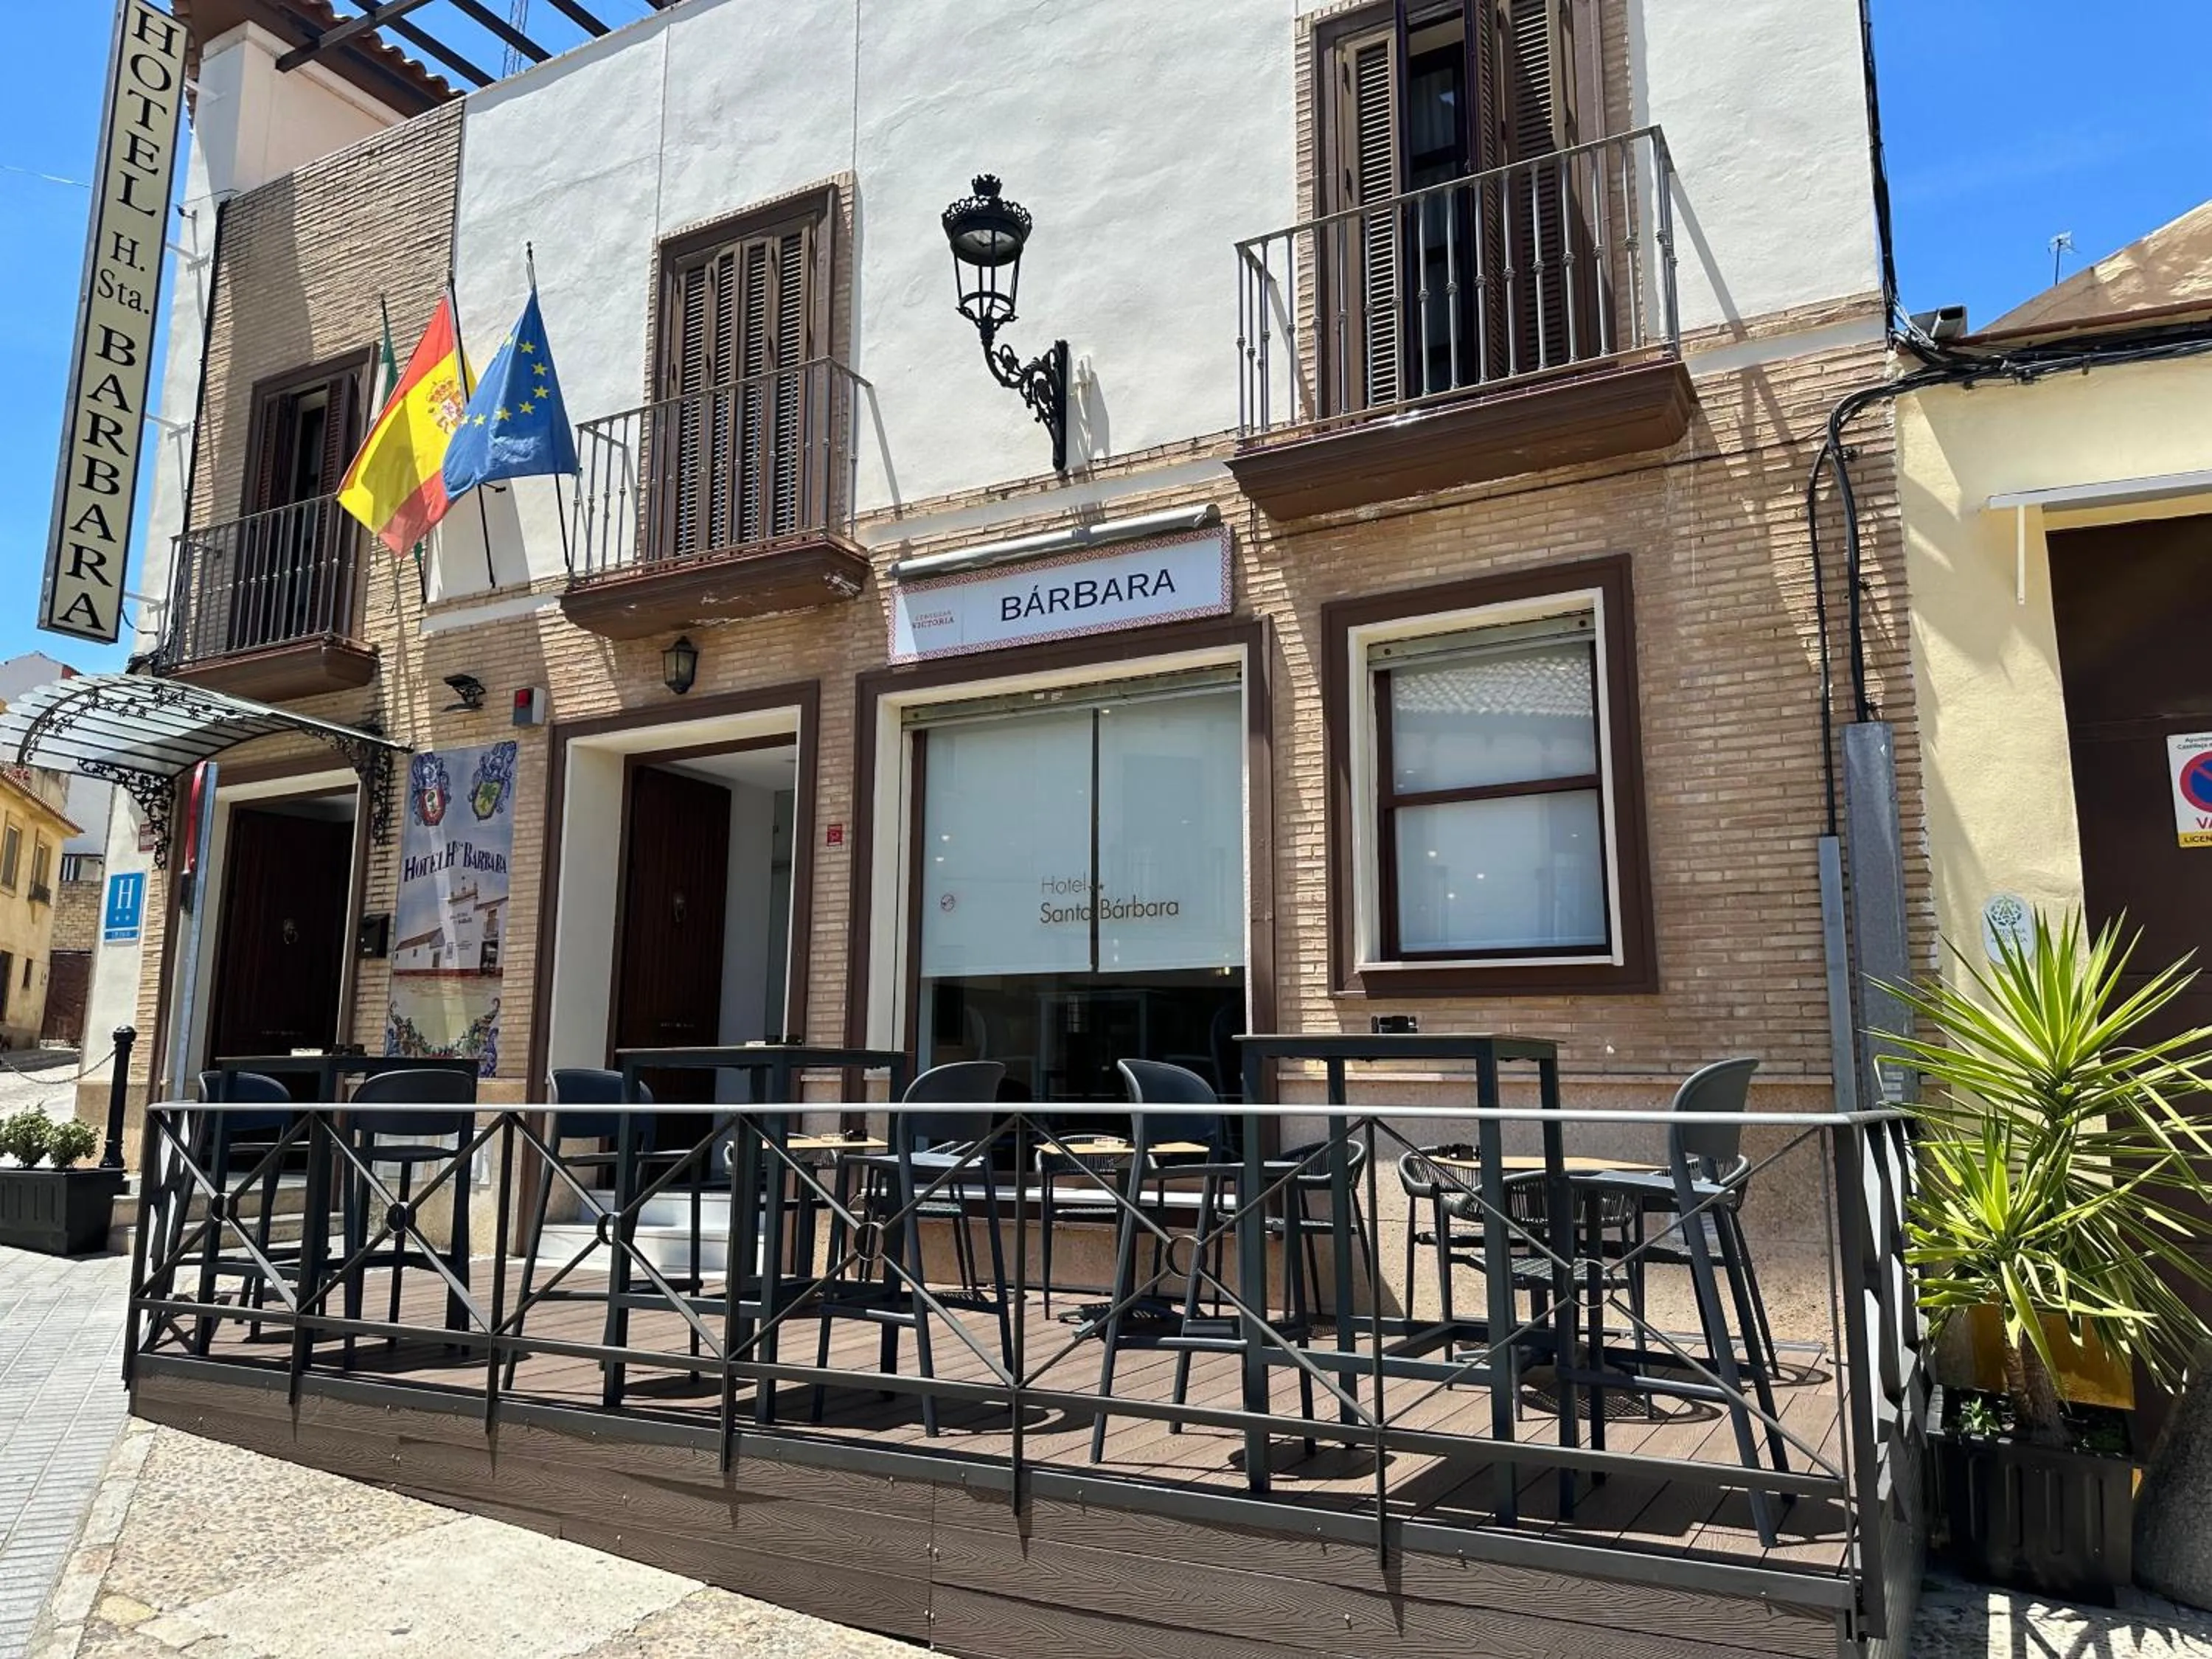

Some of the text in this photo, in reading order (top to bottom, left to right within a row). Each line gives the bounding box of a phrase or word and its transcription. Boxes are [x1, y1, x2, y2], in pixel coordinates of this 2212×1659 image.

[117, 6, 180, 217] HOTEL
[111, 231, 145, 272] H.
[97, 268, 150, 315] Sta.
[58, 324, 136, 632] BARBARA
[1001, 568, 1176, 622] BÁRBARA
[1041, 872, 1086, 895] Hotel
[1100, 894, 1180, 920] Bárbara
